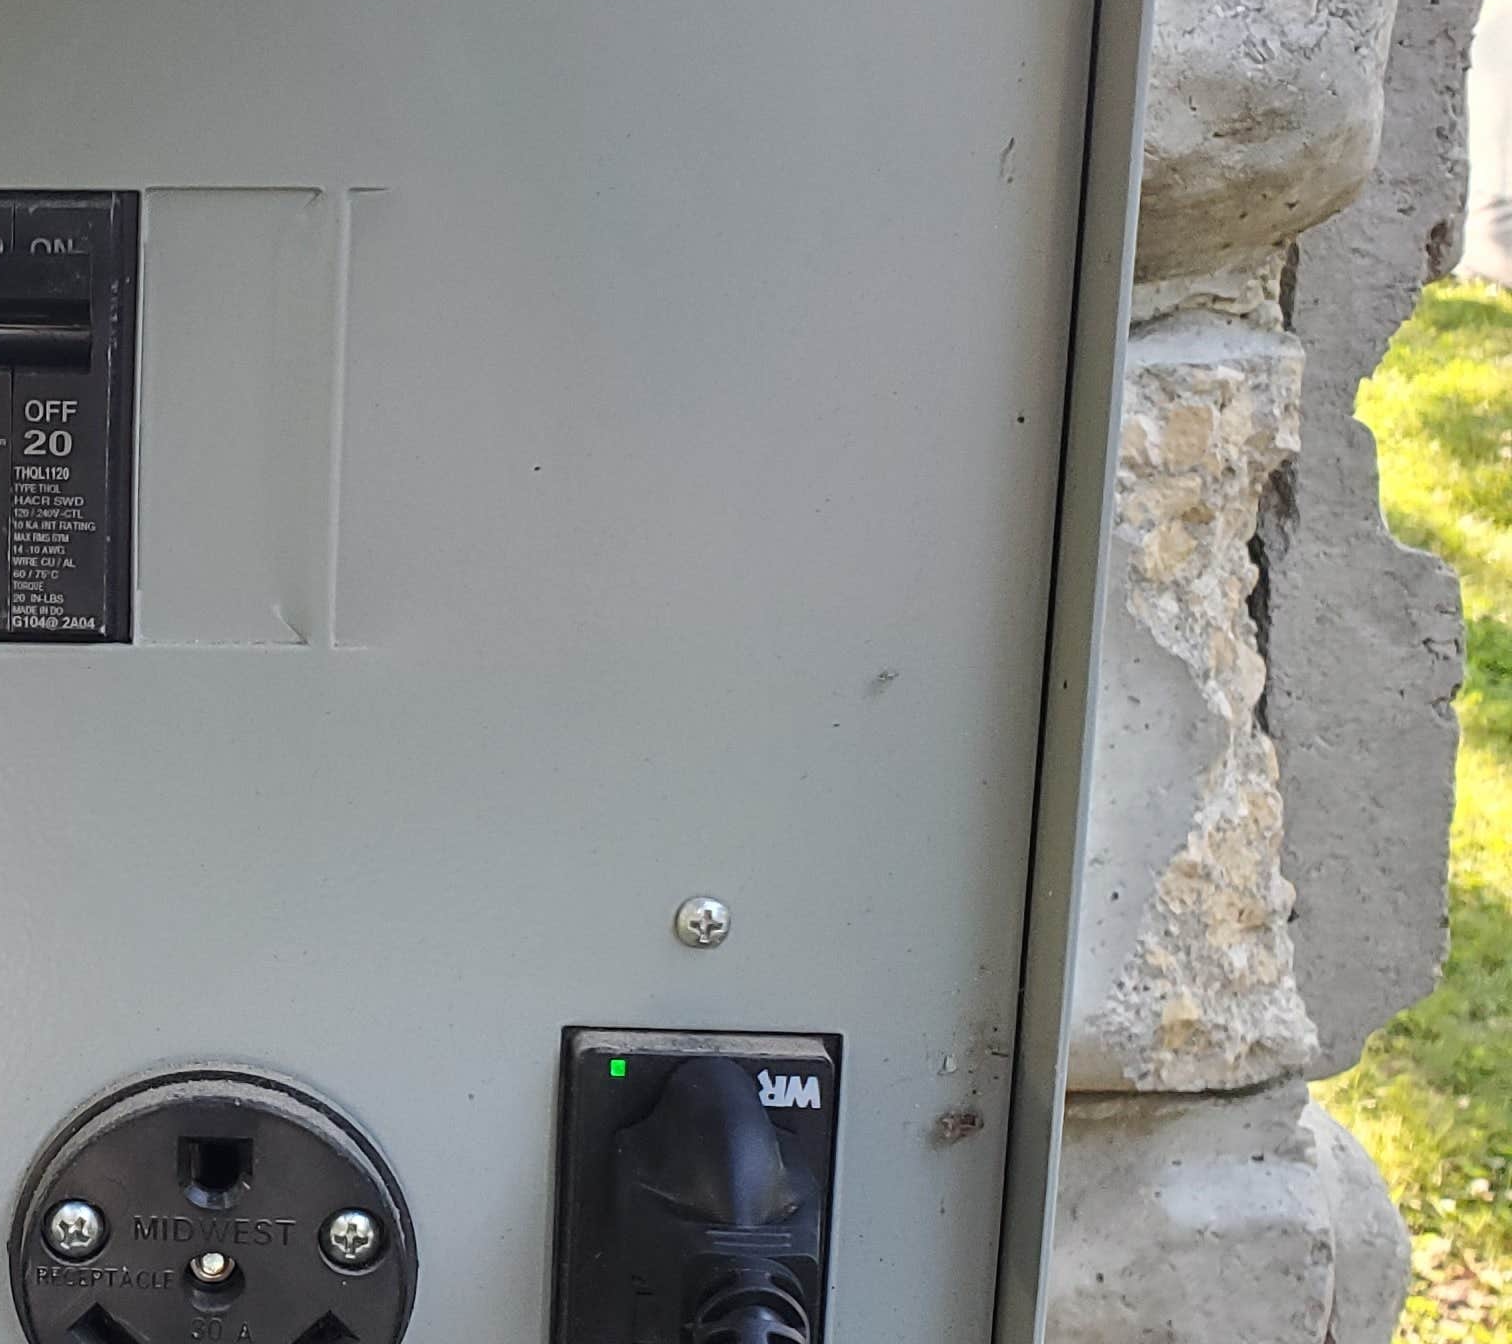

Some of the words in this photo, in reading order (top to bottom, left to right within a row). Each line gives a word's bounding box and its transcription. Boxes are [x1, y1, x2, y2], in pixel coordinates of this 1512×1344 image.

[24, 399, 78, 424] OFF
[23, 430, 73, 457] 20
[14, 466, 70, 481] THQL1120
[14, 496, 51, 506] HACR
[53, 496, 84, 507] SWD
[12, 615, 59, 630] G104@
[62, 616, 96, 630] 2A04
[757, 1070, 821, 1109] WR
[133, 1215, 297, 1247] MIDWEST
[35, 1265, 176, 1290] RECEPTACLE
[191, 1316, 223, 1341] 30
[236, 1320, 253, 1344] A
